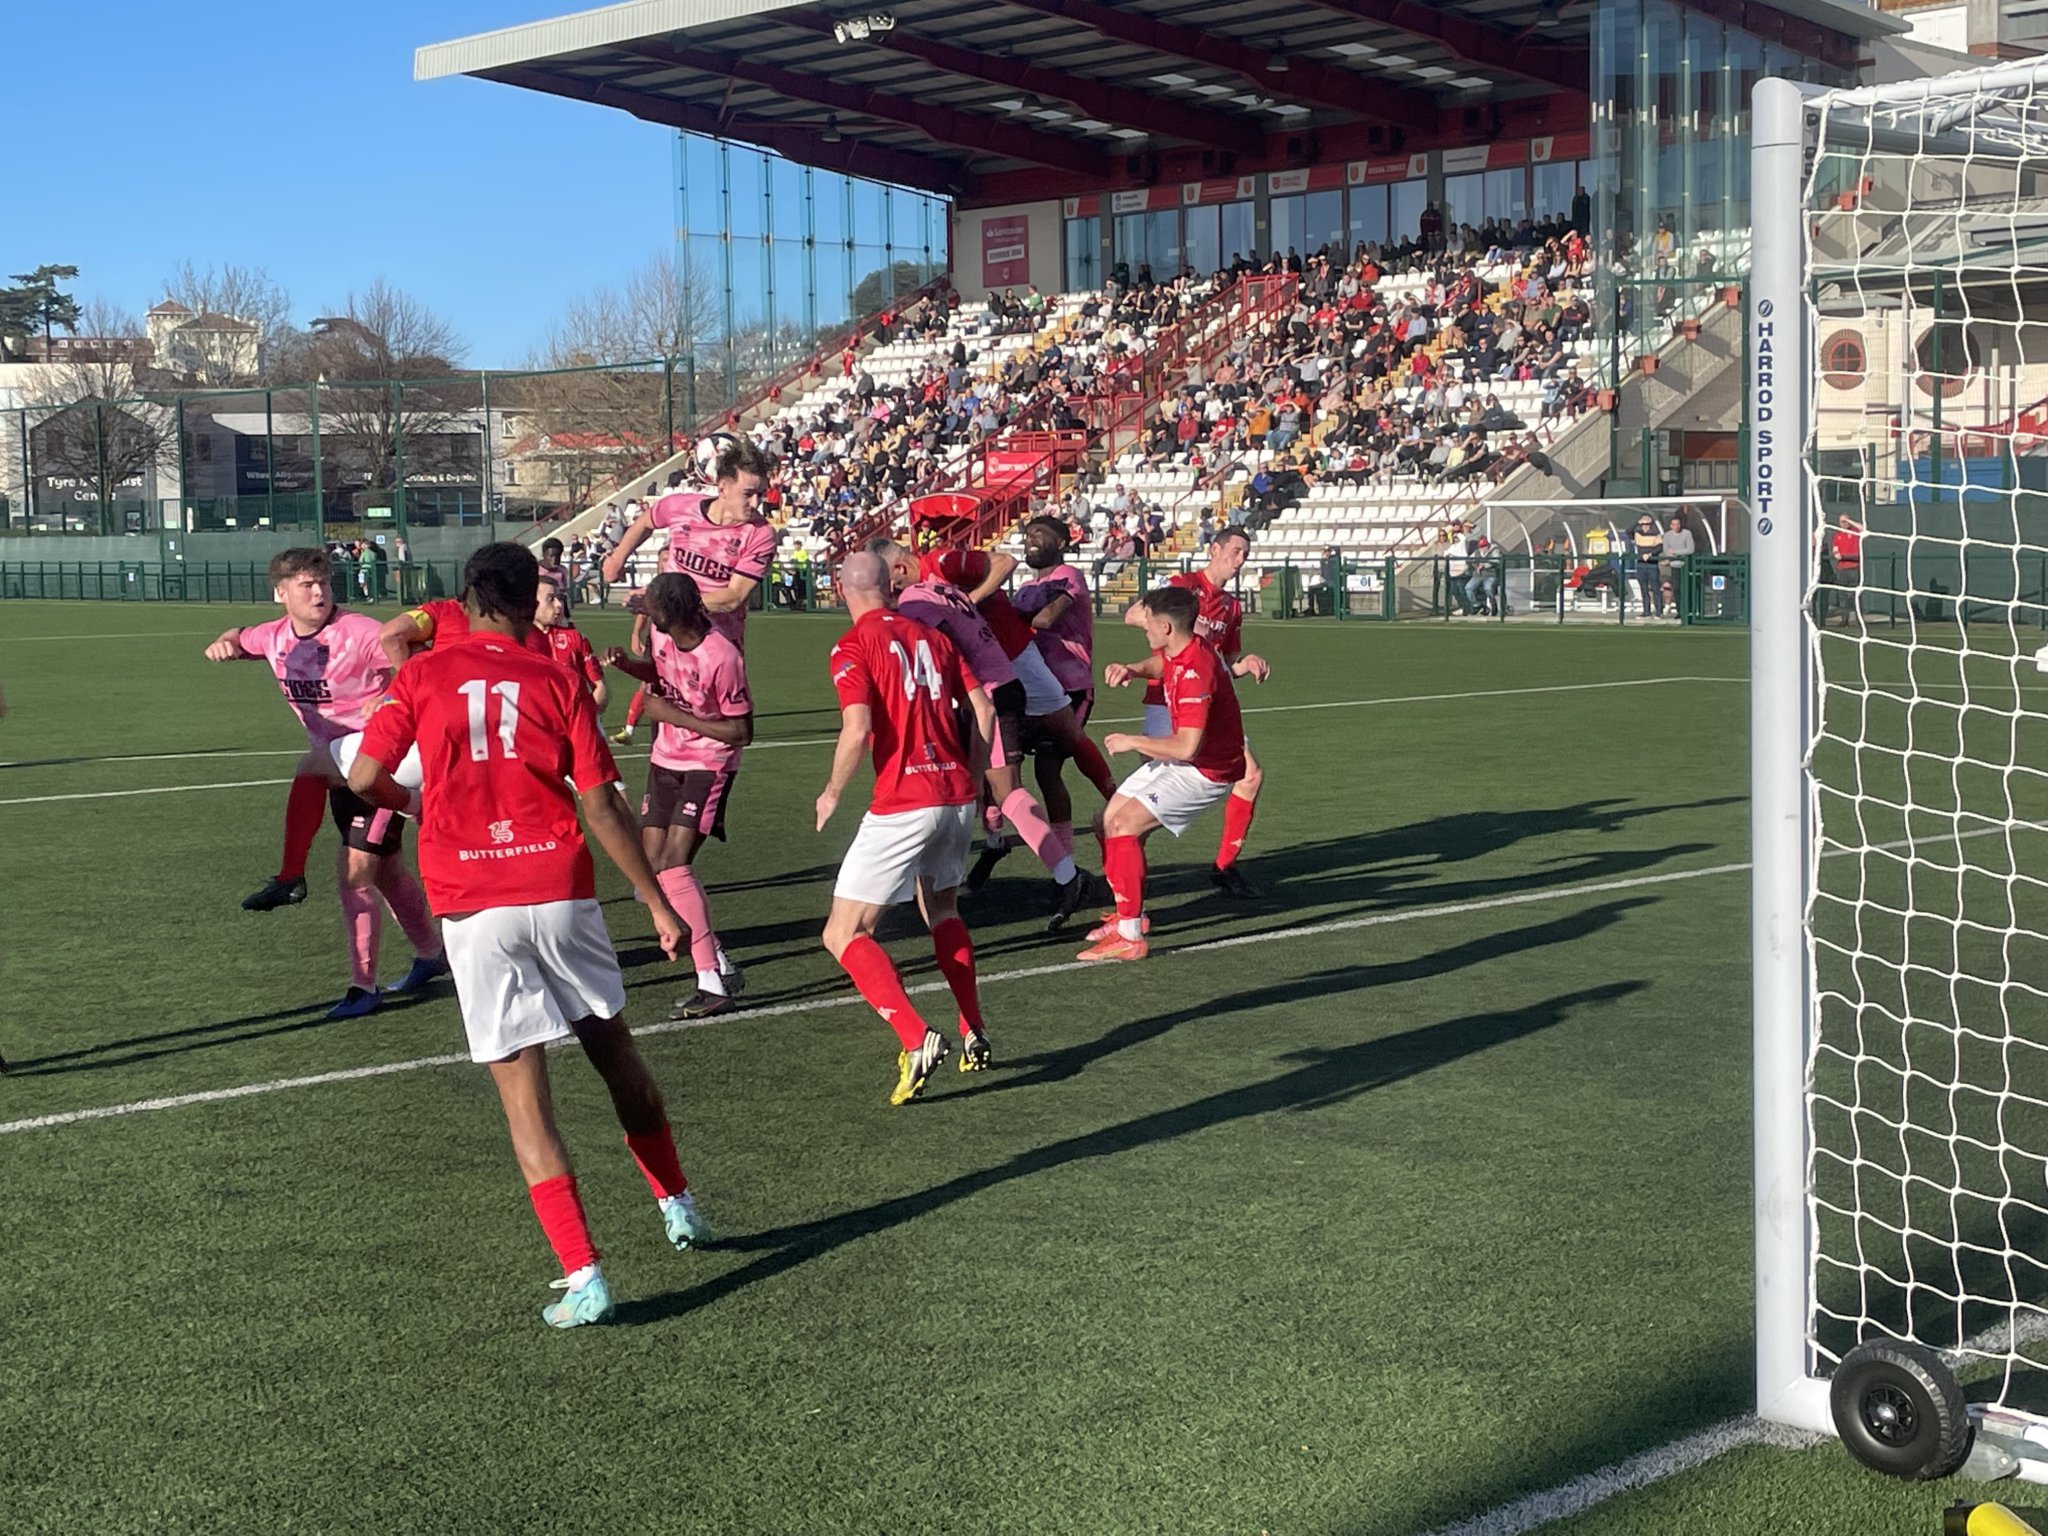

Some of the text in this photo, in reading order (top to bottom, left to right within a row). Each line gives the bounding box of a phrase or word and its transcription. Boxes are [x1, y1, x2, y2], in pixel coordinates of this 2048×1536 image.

[1757, 322, 1774, 514] HARROD SPORT
[46, 476, 76, 490] Tyre
[888, 639, 943, 702] 14
[456, 679, 521, 762] 11
[458, 840, 557, 862] BUTTERFIELD
